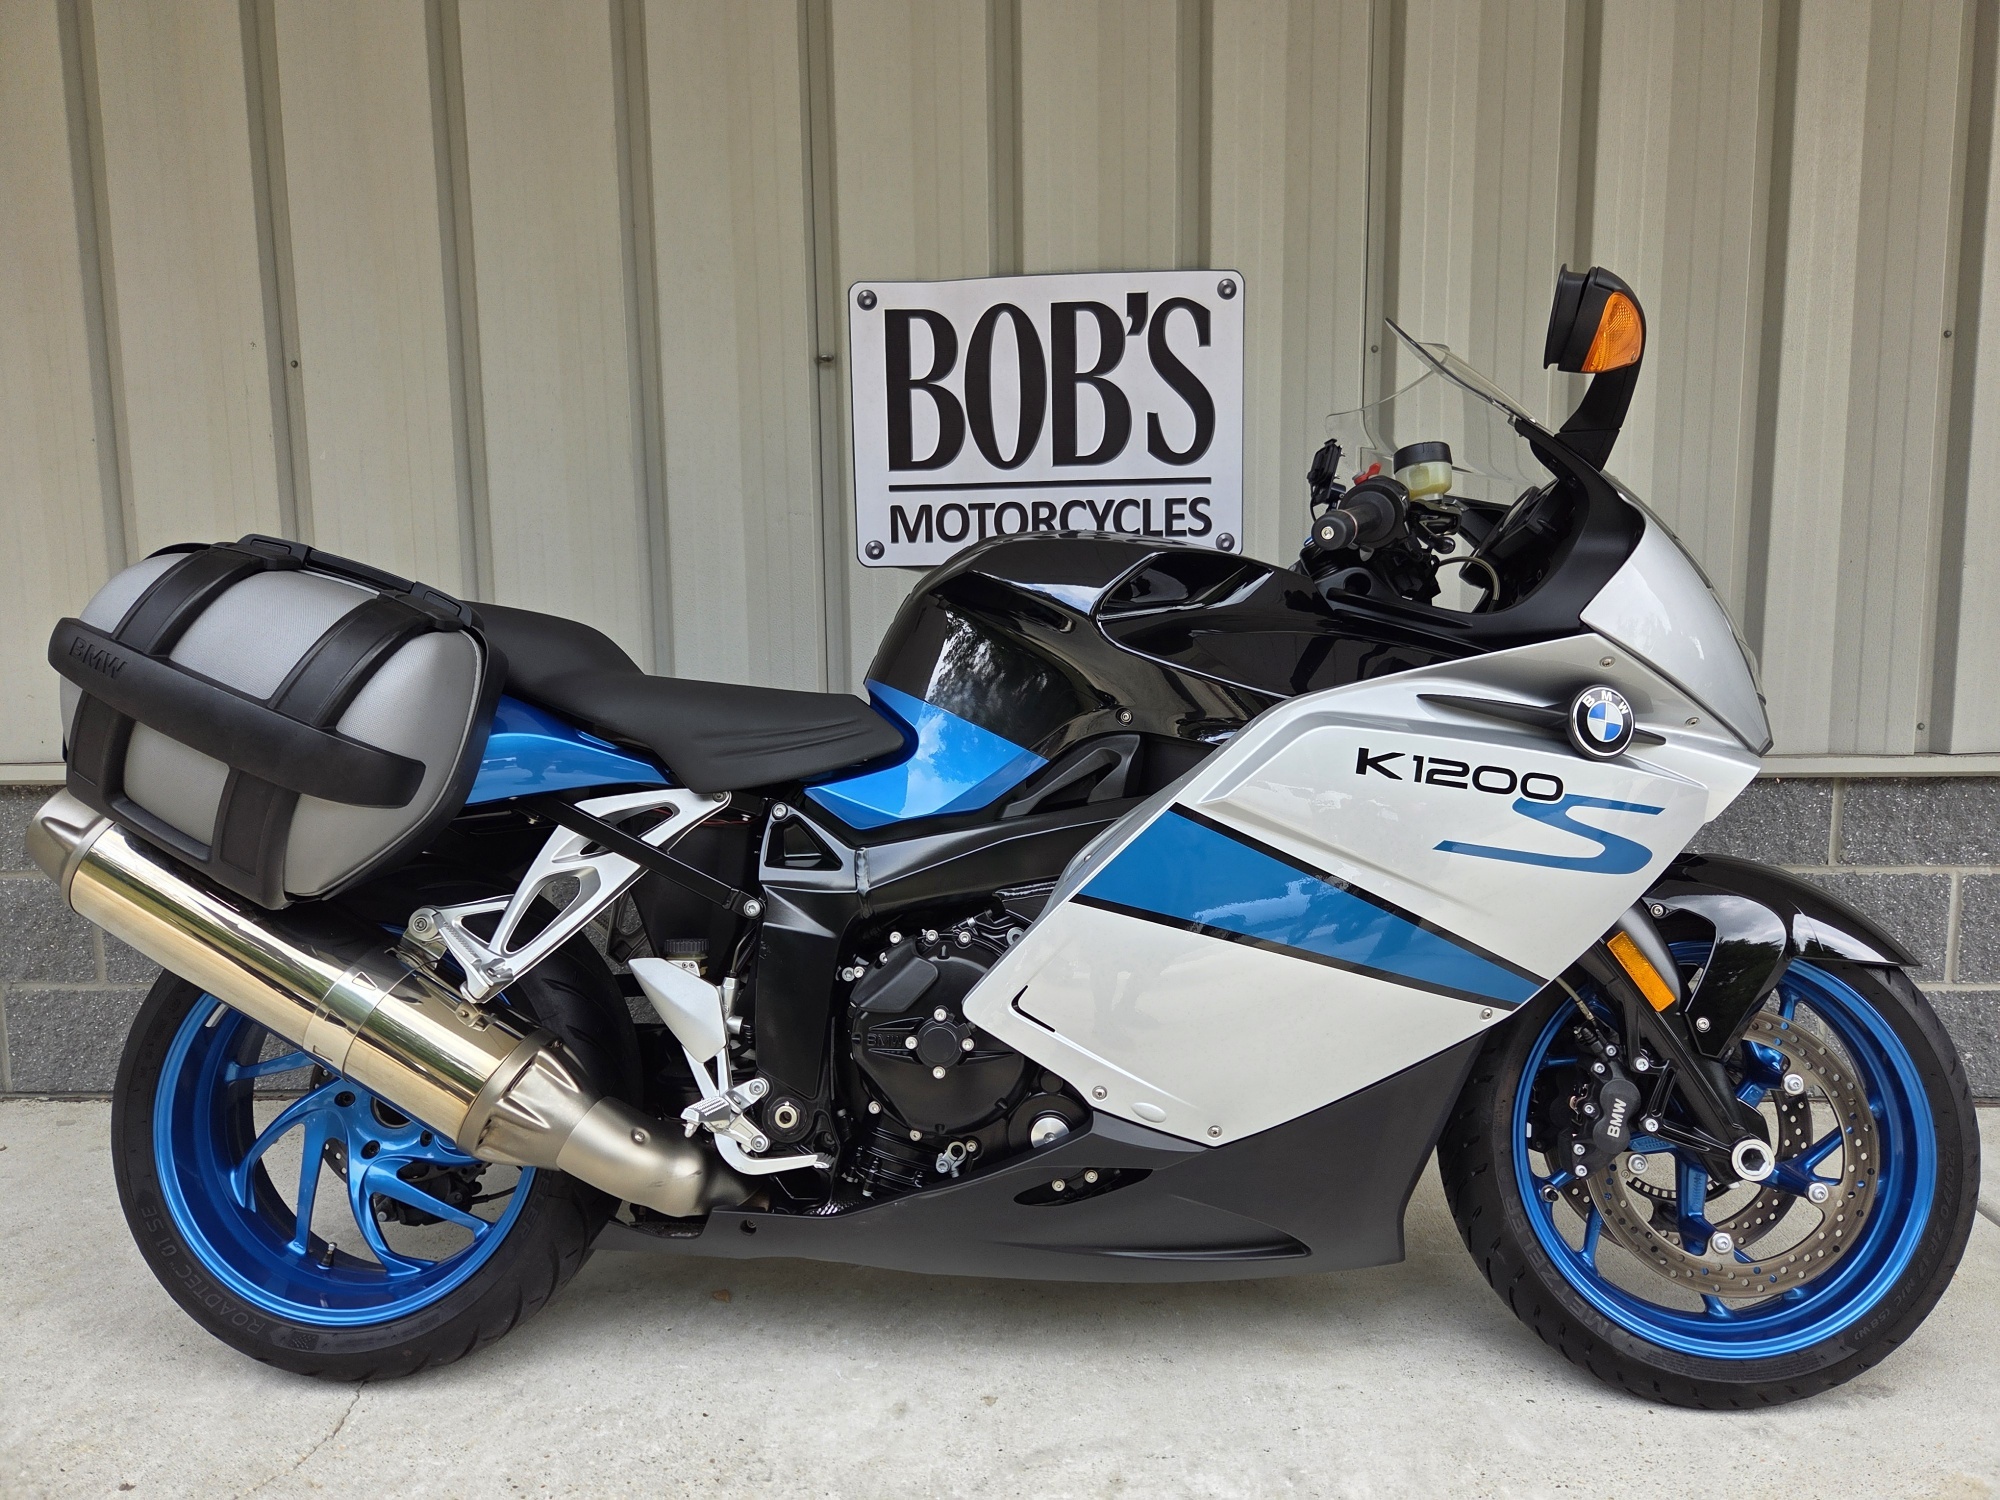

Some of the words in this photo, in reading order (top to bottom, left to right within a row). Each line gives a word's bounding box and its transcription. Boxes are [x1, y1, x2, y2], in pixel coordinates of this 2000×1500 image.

[884, 292, 1216, 472] BOB'S
[889, 497, 1212, 544] MOTORCYCLES
[70, 636, 127, 679] BMW
[1582, 689, 1629, 715] BMW
[1432, 793, 1666, 876] S
[867, 1033, 904, 1048] BMW
[1607, 1098, 1627, 1138] BMW
[141, 1205, 164, 1233] SE
[156, 1237, 178, 1257] 01
[1505, 1195, 1609, 1337] METZELER
